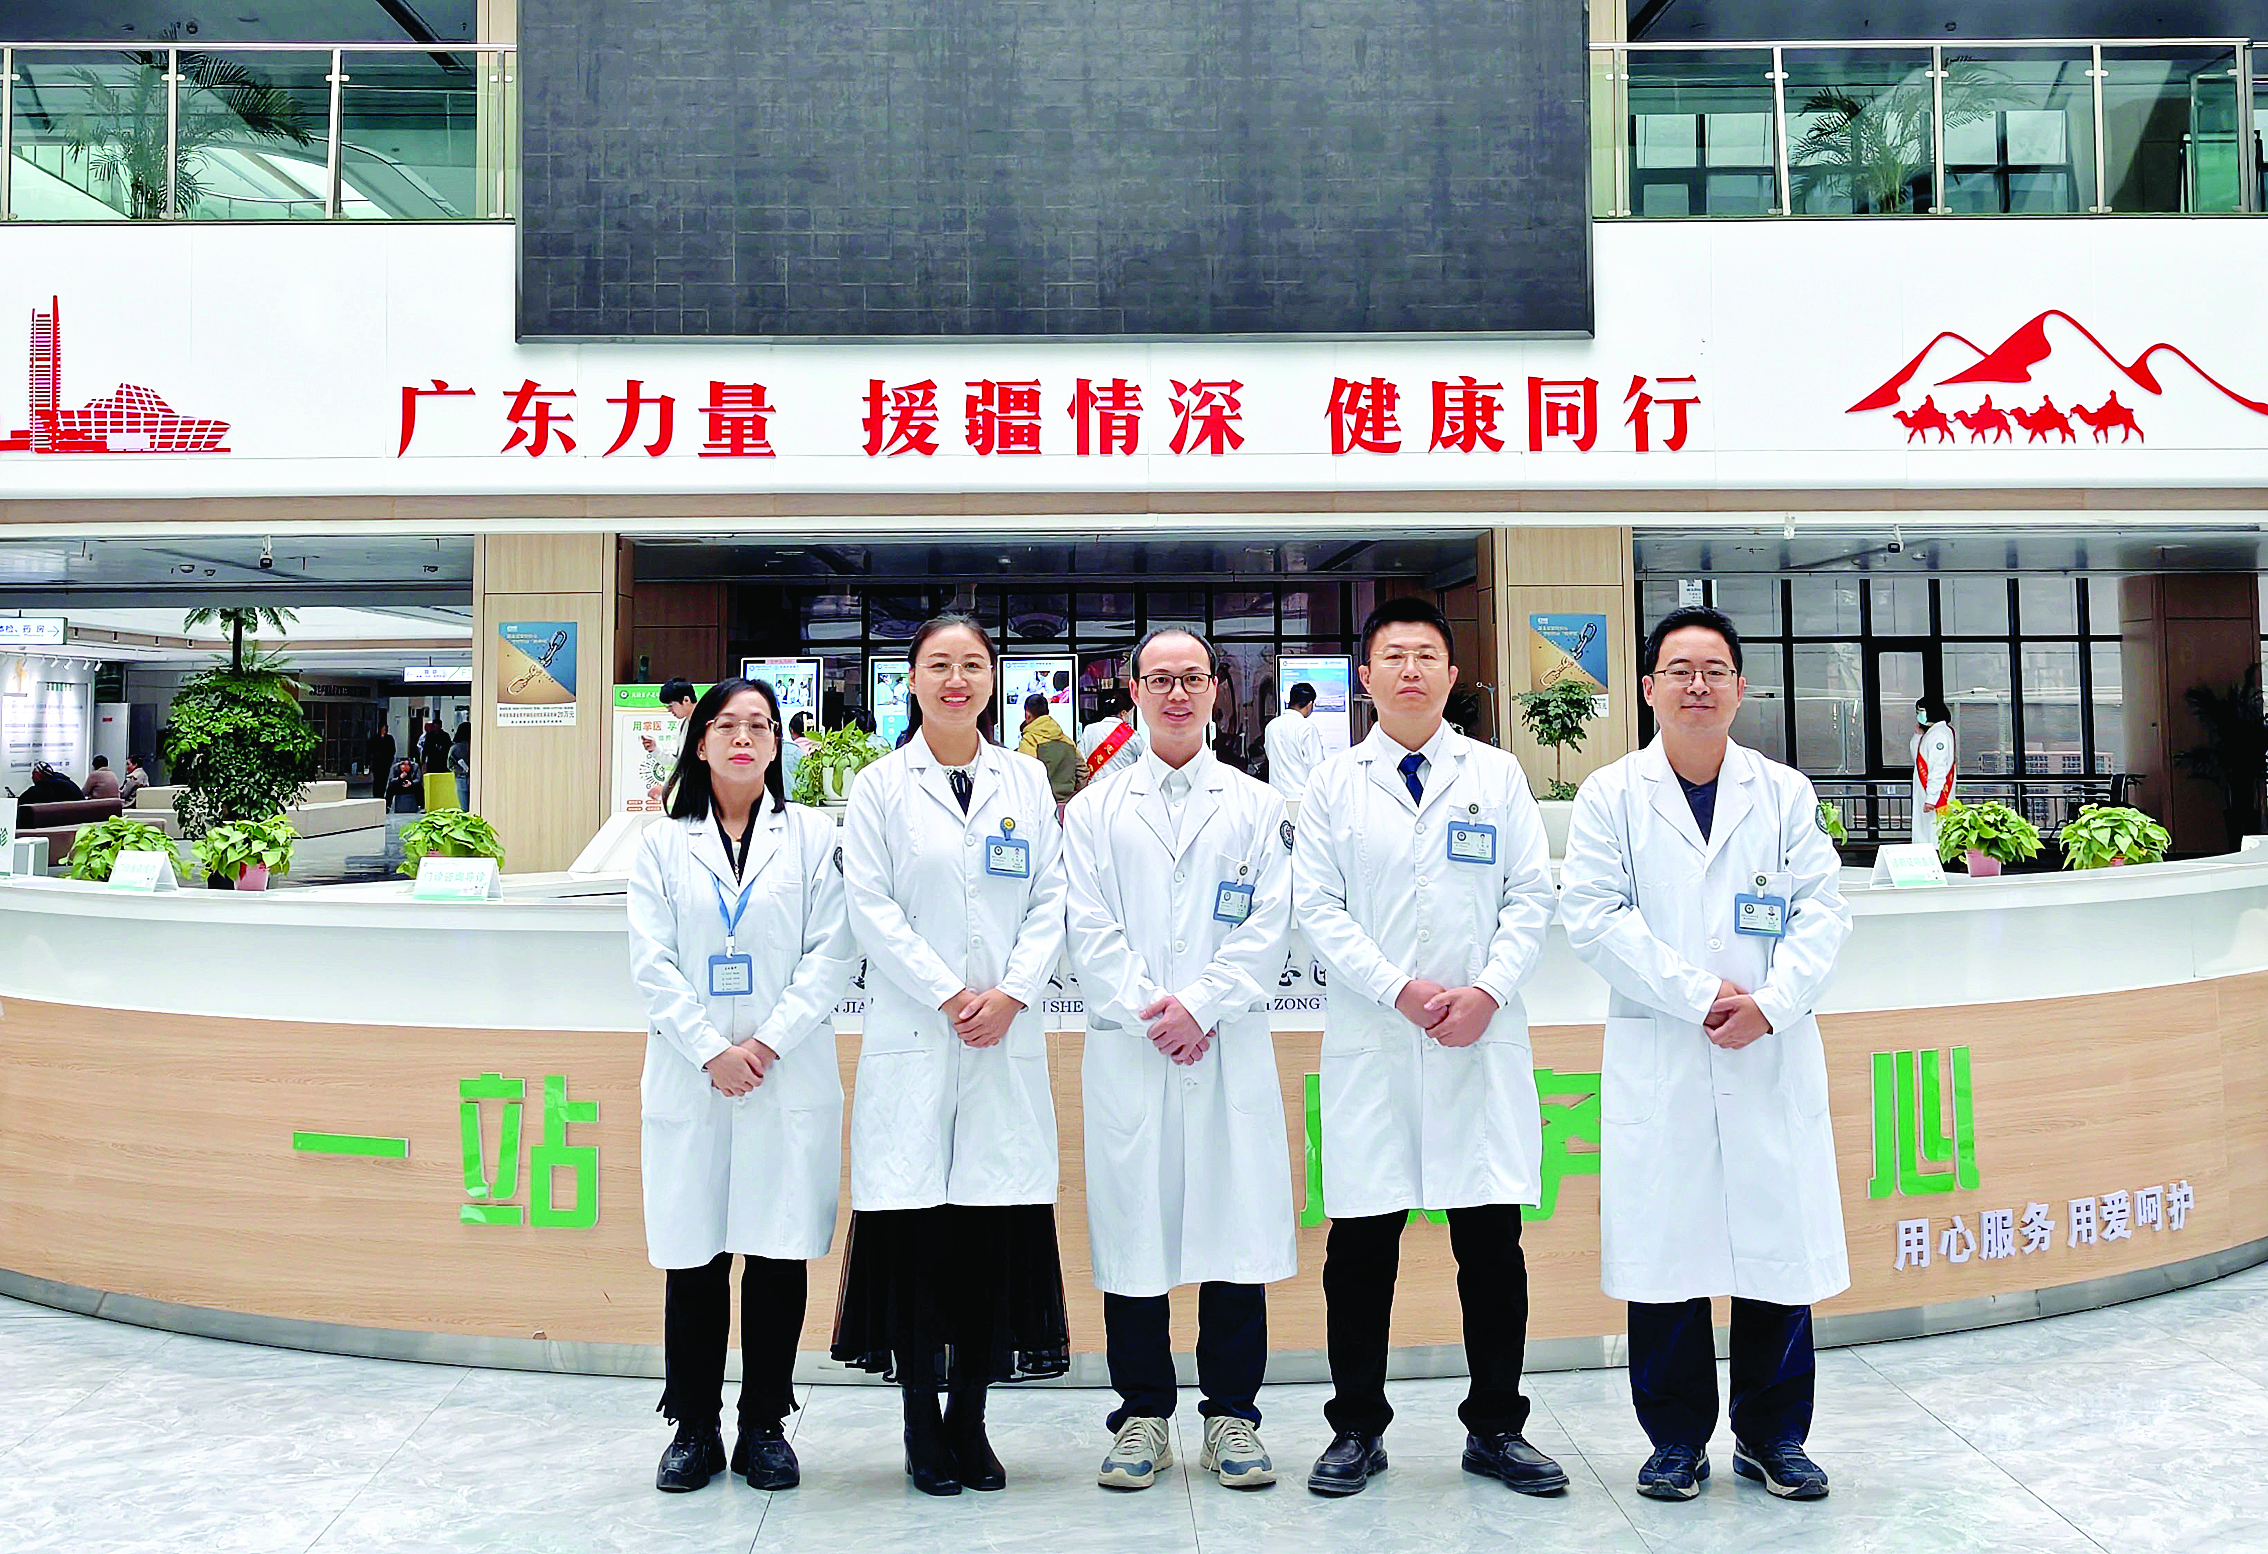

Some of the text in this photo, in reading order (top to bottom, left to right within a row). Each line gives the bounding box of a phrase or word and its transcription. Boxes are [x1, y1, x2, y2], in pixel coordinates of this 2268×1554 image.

[398, 375, 1700, 458] 广东力量 援疆情深 健康同行
[1274, 997, 1320, 1011] ZONG
[1893, 1180, 2195, 1271] 用心服务 用爱呵护
